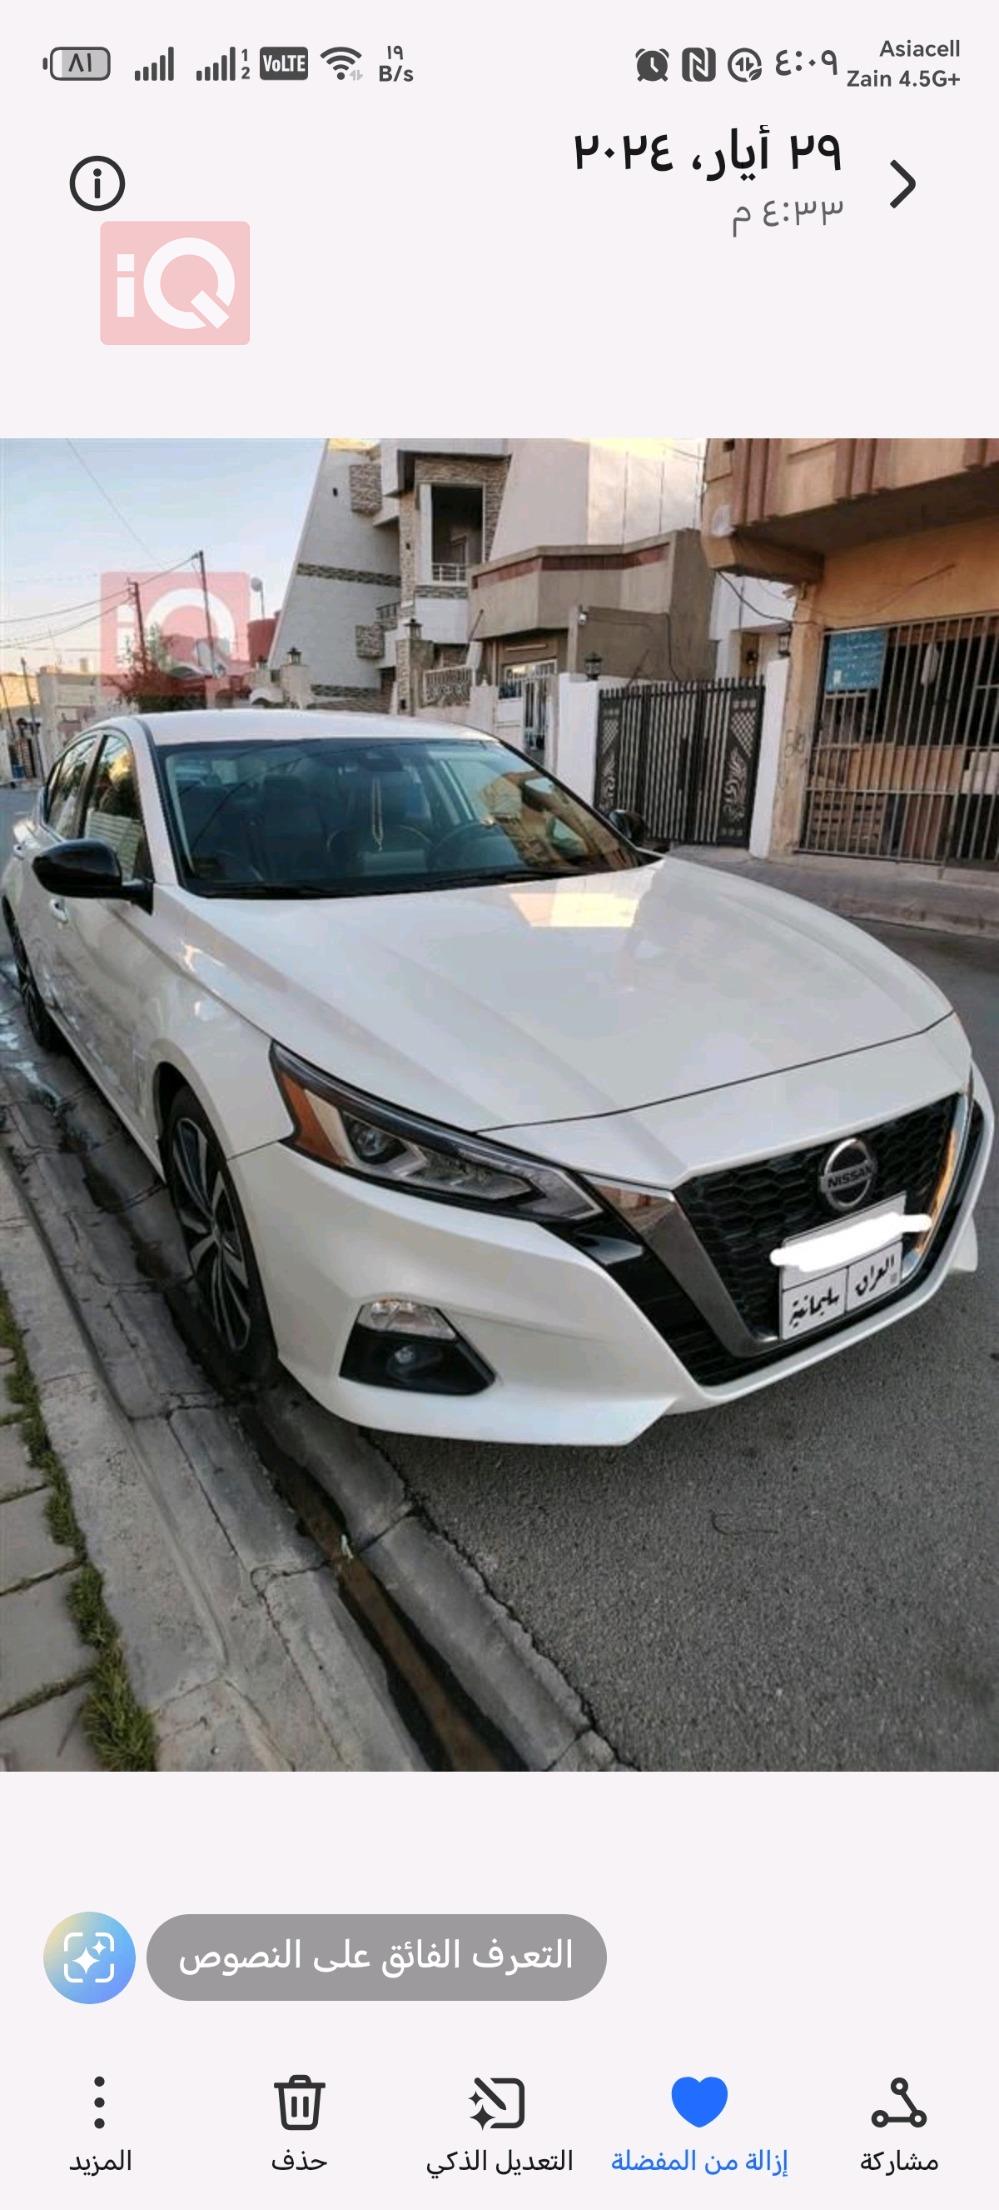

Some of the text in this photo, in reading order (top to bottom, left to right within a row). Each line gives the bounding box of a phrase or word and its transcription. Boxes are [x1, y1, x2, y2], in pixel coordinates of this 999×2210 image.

[879, 39, 960, 58] Asiacell
[263, 54, 306, 73] VoLTE
[378, 64, 414, 83] B/s
[775, 49, 838, 77] ٤:٠٩
[846, 69, 961, 88] Zain 4.5G+
[574, 133, 674, 173] ٢٠٢٤
[790, 134, 842, 171] ٢٩
[732, 200, 844, 238] ٤:٣٣ م
[827, 1165, 874, 1190] NISSAN
[854, 1254, 895, 1297] العراق
[179, 1937, 572, 1979] التعرف الفائق على النصوص
[69, 2148, 132, 2177] المزيد
[271, 2148, 328, 2171] حذف
[426, 2148, 573, 2180] التعديل الذكي
[611, 2148, 789, 2178] إزالة من المفضلة
[860, 2149, 939, 2177] مشاركة
